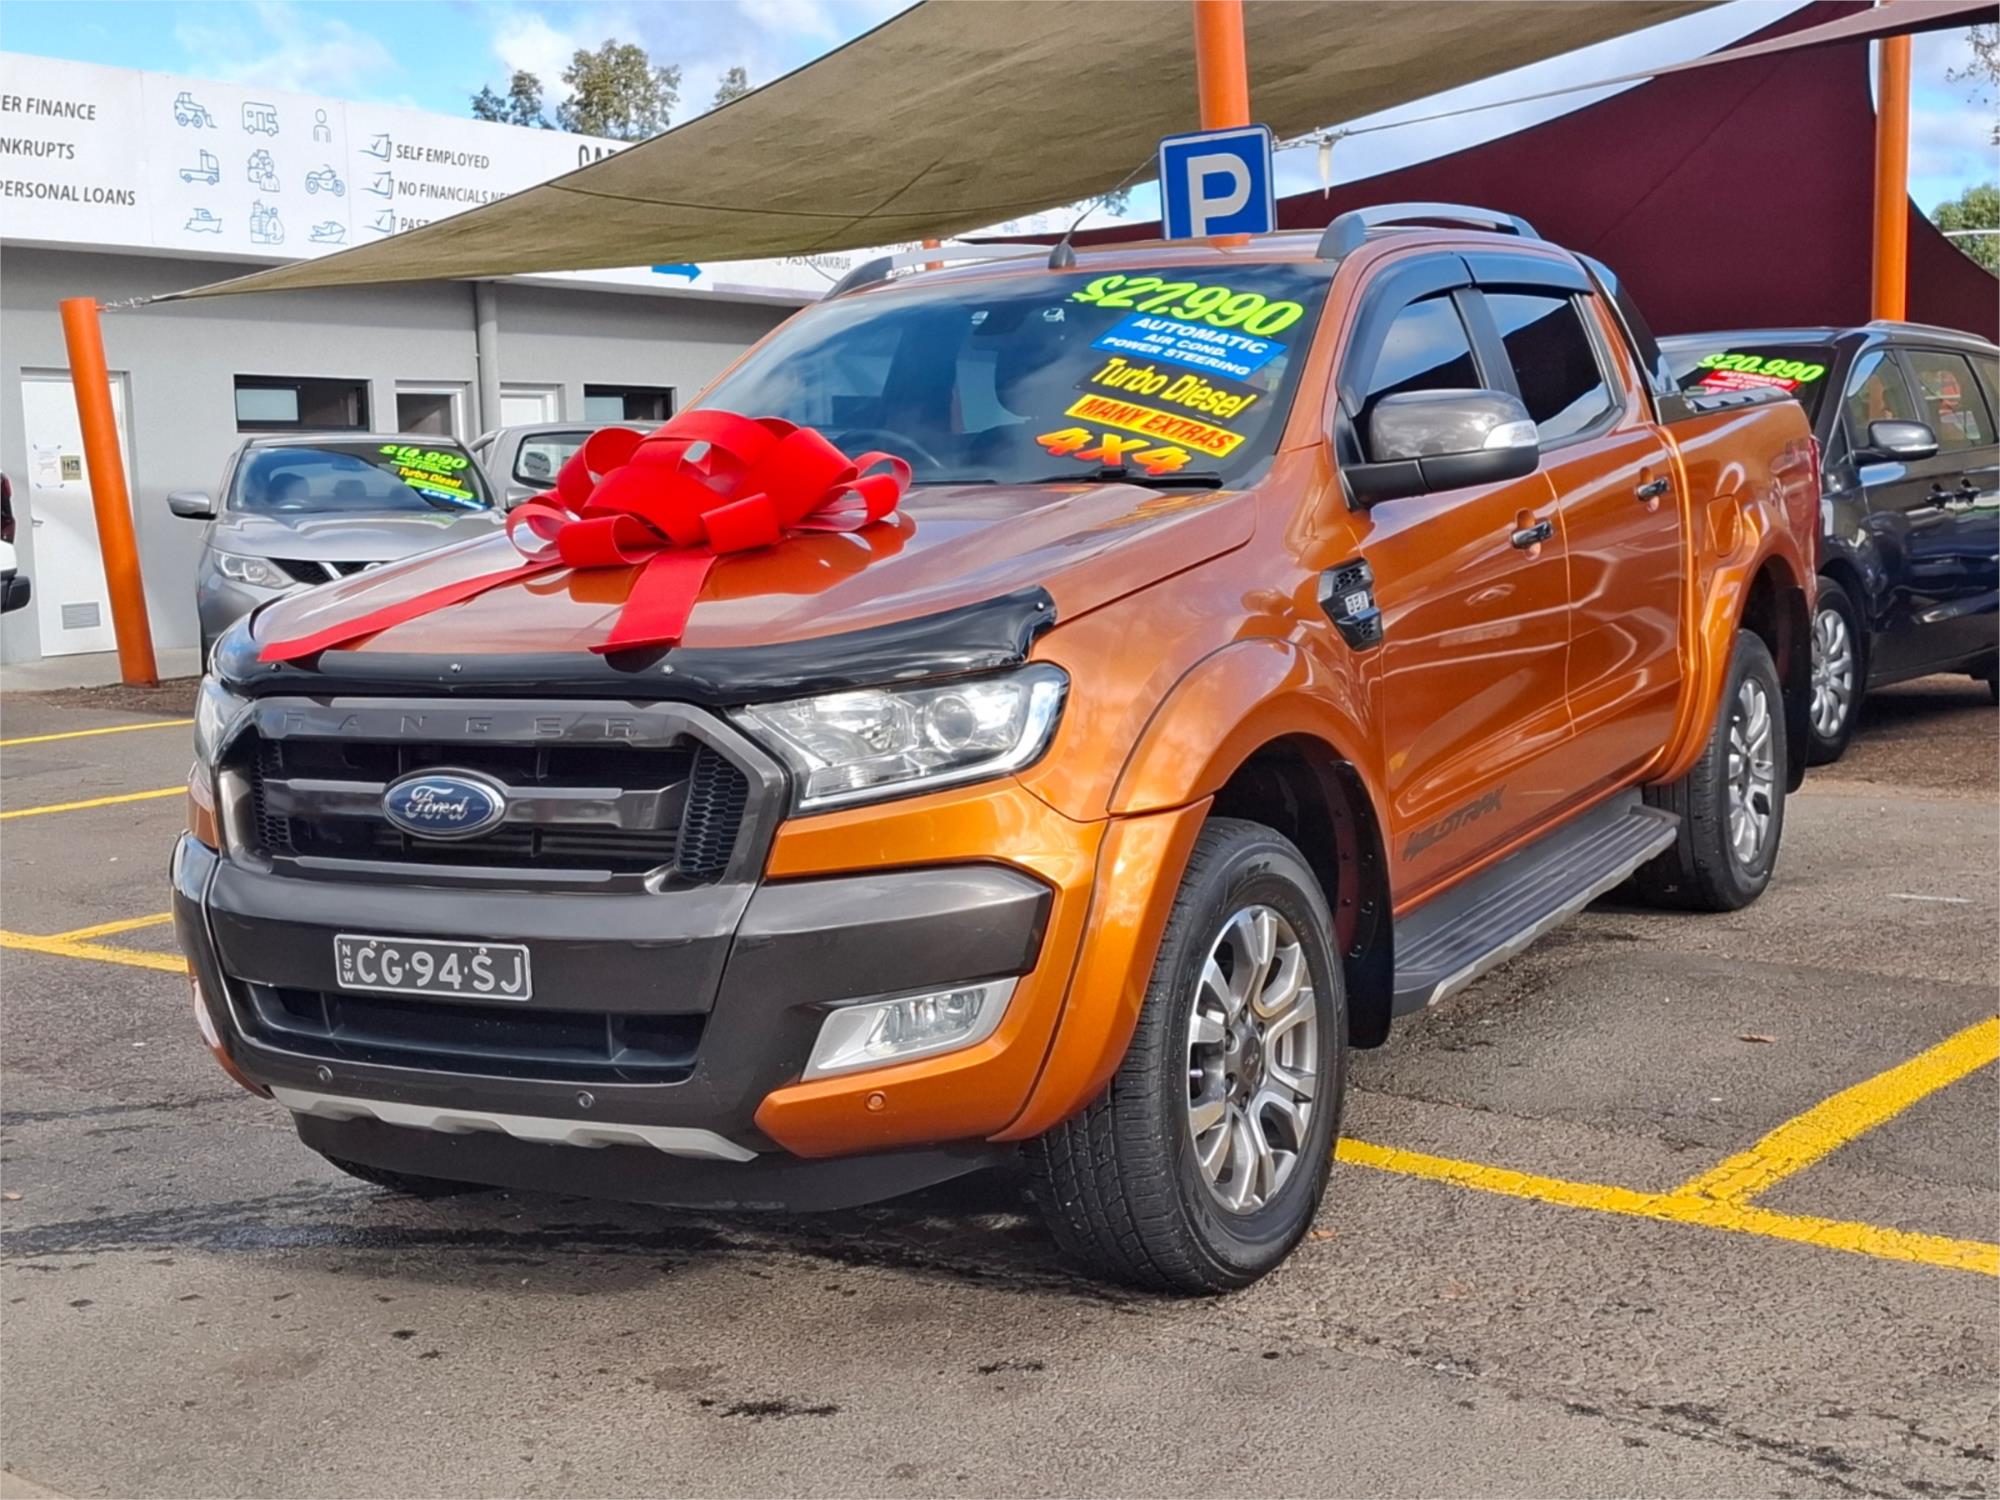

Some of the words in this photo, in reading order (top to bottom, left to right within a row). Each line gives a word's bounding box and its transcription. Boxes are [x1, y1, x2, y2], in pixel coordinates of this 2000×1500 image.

[26, 97, 97, 121] FINANCE
[396, 143, 424, 161] SELF
[426, 147, 490, 169] EMPLOYED
[84, 186, 136, 206] LOANS
[398, 181, 417, 197] NO
[419, 183, 488, 204] FINANCIALS
[1186, 152, 1252, 238] P
[1131, 317, 1269, 354] AUTOMATIC
[1143, 333, 1176, 345] AIR
[1176, 339, 1228, 357] COND.
[1101, 336, 1163, 354] POWER
[1163, 348, 1251, 376] STEERING
[1091, 357, 1169, 395] Turbo
[1160, 374, 1258, 418] Diesel
[1075, 398, 1140, 423] MANY
[1142, 414, 1235, 451] EXTRAS
[399, 466, 429, 480] Turbo
[281, 710, 638, 738] RANGER
[404, 784, 469, 822] Ford
